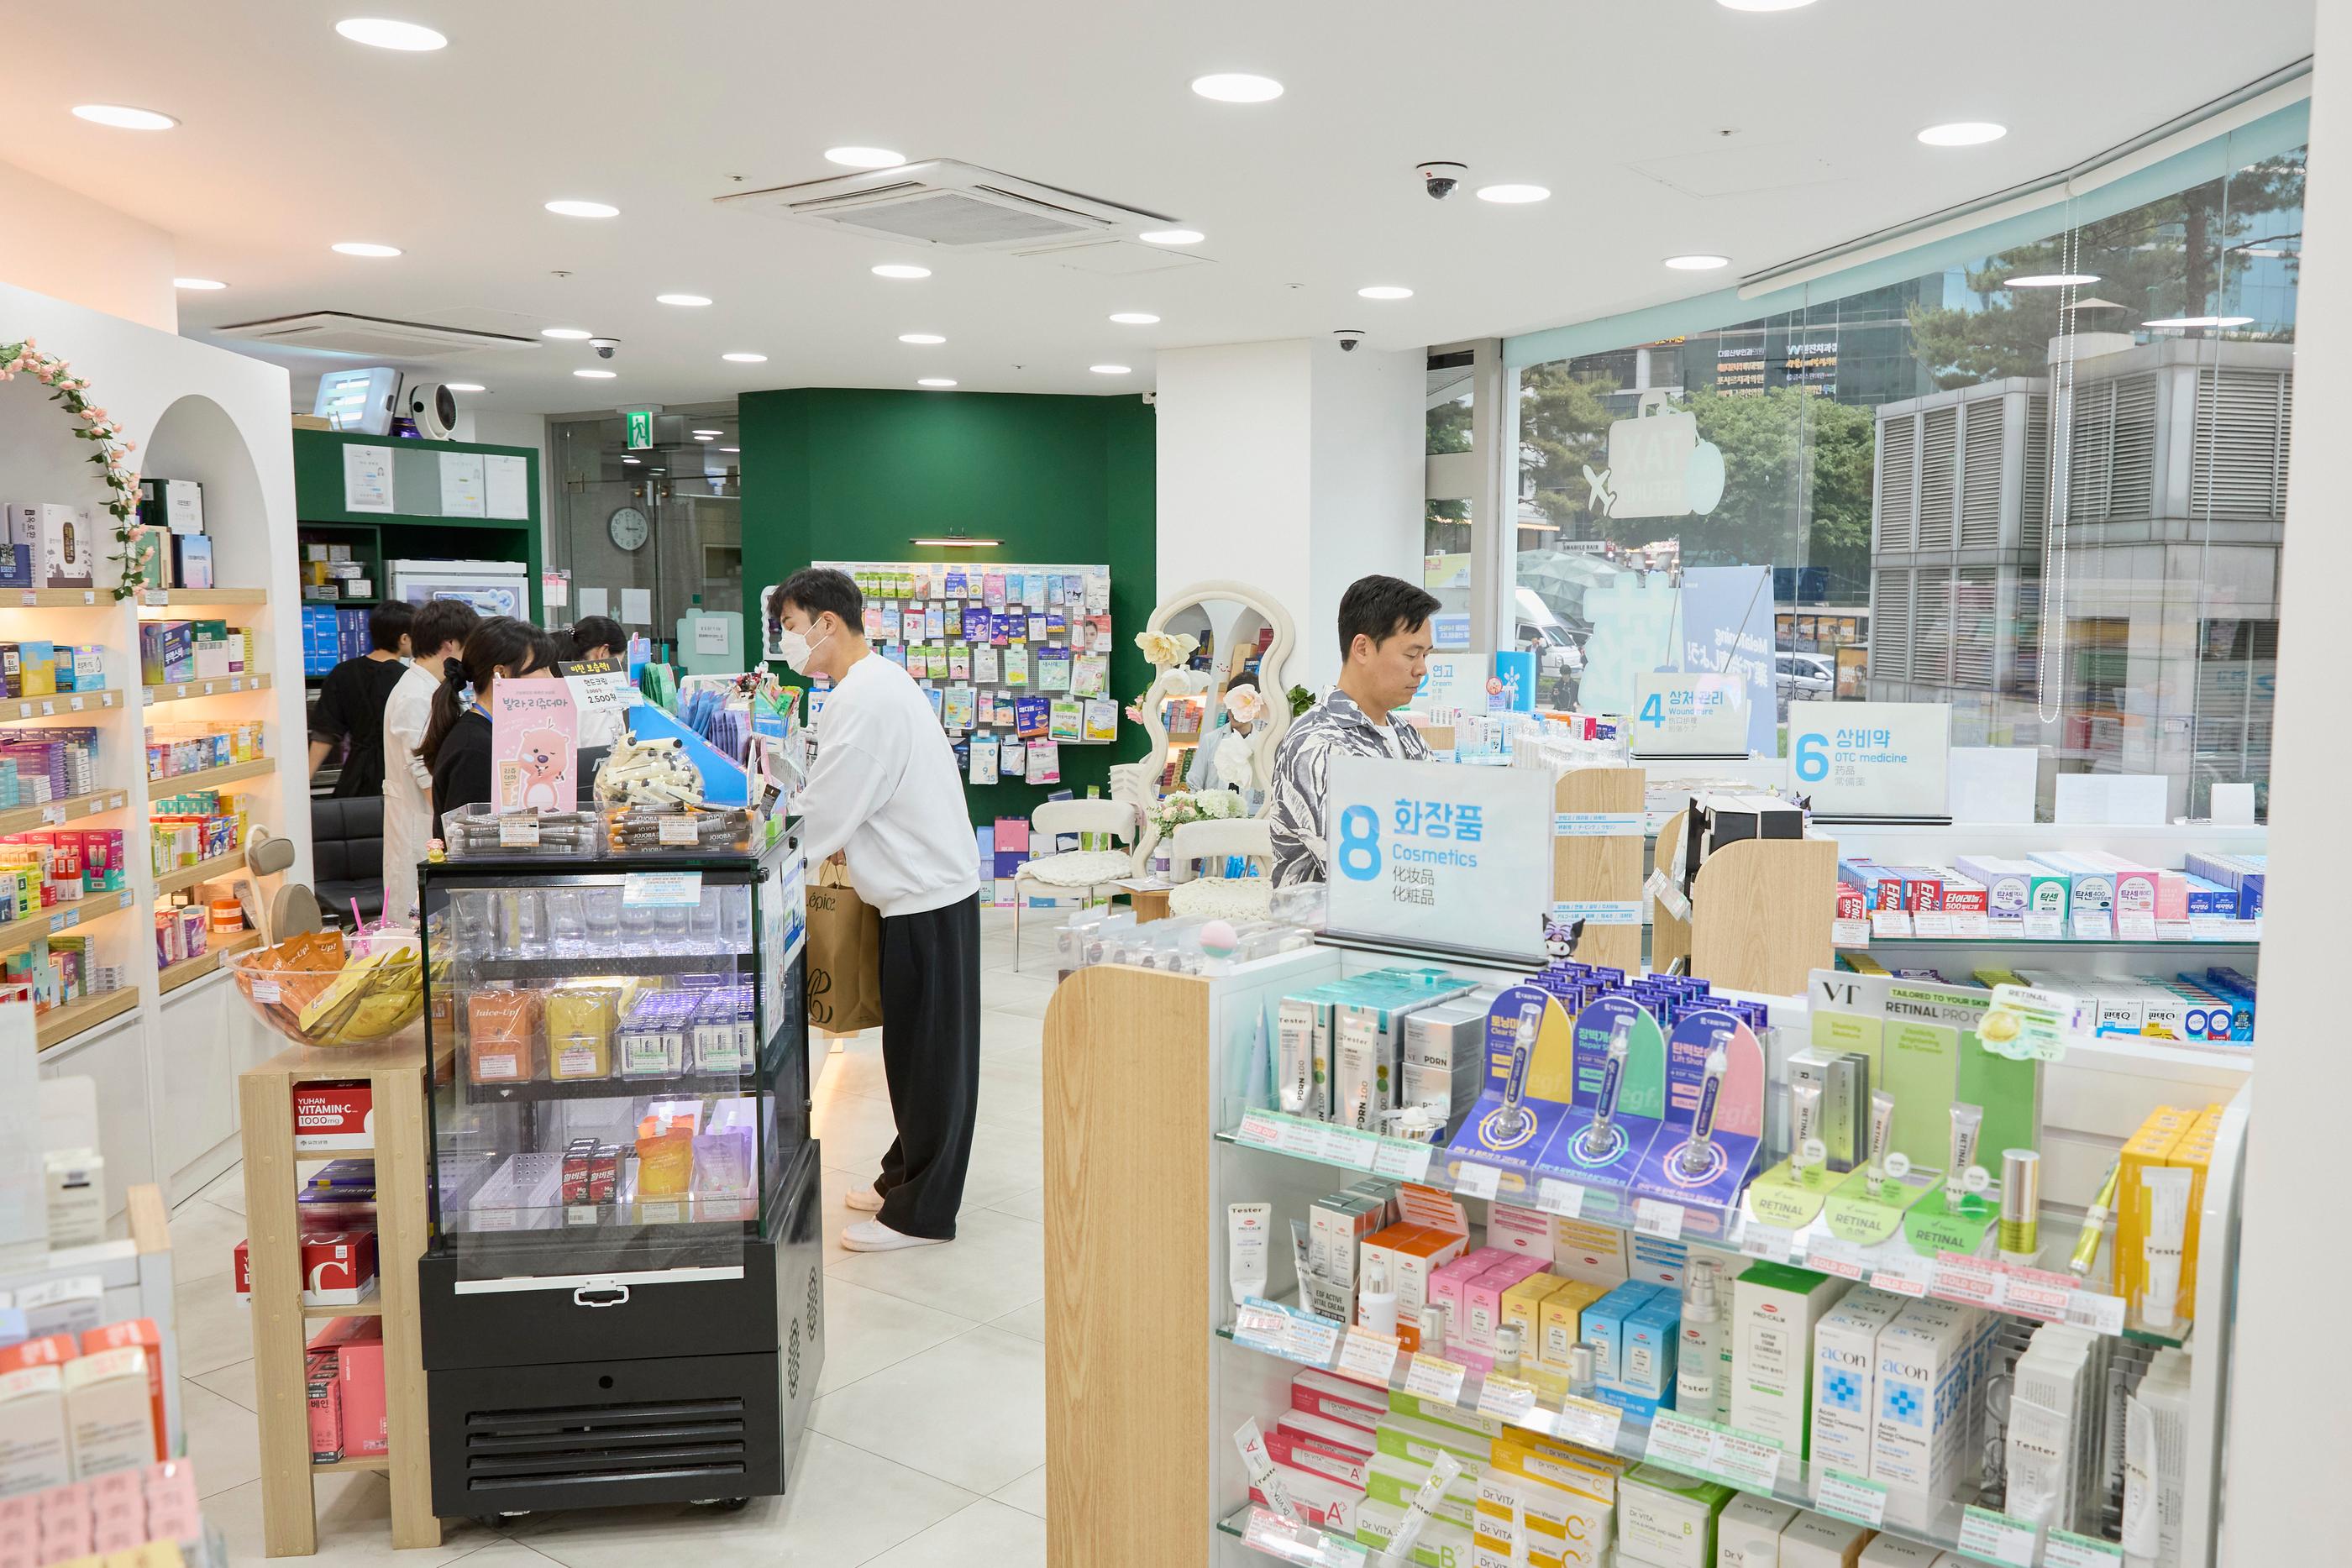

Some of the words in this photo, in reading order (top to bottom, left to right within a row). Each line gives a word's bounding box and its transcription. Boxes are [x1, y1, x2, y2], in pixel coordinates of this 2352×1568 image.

[1669, 690, 1694, 705] 상처
[1698, 691, 1723, 705] 관리
[1640, 694, 1666, 728] 4
[1836, 729, 1891, 748] 상비약
[1796, 733, 1830, 782] 6
[1835, 753, 1856, 762] OTC
[1860, 753, 1908, 763] medicine
[1394, 799, 1483, 842] 화장품
[1339, 805, 1382, 882] 8
[1393, 844, 1478, 868] Cosmetics
[1393, 866, 1435, 885] 化妆品
[1393, 886, 1435, 905] 化粧品
[1997, 891, 2013, 901] 탁센
[2040, 893, 2059, 902] 탁센
[2075, 890, 2092, 901] 탁센
[2121, 889, 2139, 900] 탁센
[1823, 981, 1861, 1005] VT
[1892, 989, 1931, 1000] TAILORED
[1946, 996, 1969, 1005] YOUR
[1971, 999, 1991, 1007] SKIN
[1886, 1001, 1939, 1018] RETINAL
[1942, 1009, 1970, 1022] PRO
[1343, 1036, 1368, 1046] Tester
[1578, 1028, 1612, 1043] 장벽개
[1672, 1041, 1709, 1057] 탄력보
[1424, 1055, 1447, 1067] PDRN
[1357, 1102, 1367, 1130] PDRN
[1957, 1133, 1968, 1168] RETINAL
[1759, 1198, 1803, 1216] RETINAL
[1835, 1214, 1882, 1231] RETINAL
[1915, 1230, 1965, 1248] RETINAL
[1814, 1256, 1837, 1272] SOLD
[1839, 1262, 1861, 1276] OUT
[1874, 1274, 1899, 1288] SOLD
[1901, 1280, 1923, 1293] OUT
[1943, 1274, 1968, 1288] SOLD
[1970, 1281, 1992, 1293] OUT
[1325, 1293, 1343, 1303] ACTIVE
[2013, 1287, 2040, 1300] SOLD
[2042, 1293, 2065, 1305] OUT
[1327, 1301, 1345, 1312] CREAM
[1753, 1310, 1786, 1323] PRO-CALM
[1821, 1345, 1866, 1368] acon
[1882, 1358, 1929, 1382] acon
[1818, 1408, 1836, 1418] Acon
[1483, 1417, 1491, 1430] B
[1878, 1422, 1898, 1432] Acon
[2014, 1439, 2057, 1456] Tester
[1326, 1502, 1343, 1525] A
[1565, 1514, 1585, 1540] C
[1683, 1522, 1693, 1535] B
[1441, 1545, 1457, 1568] B
